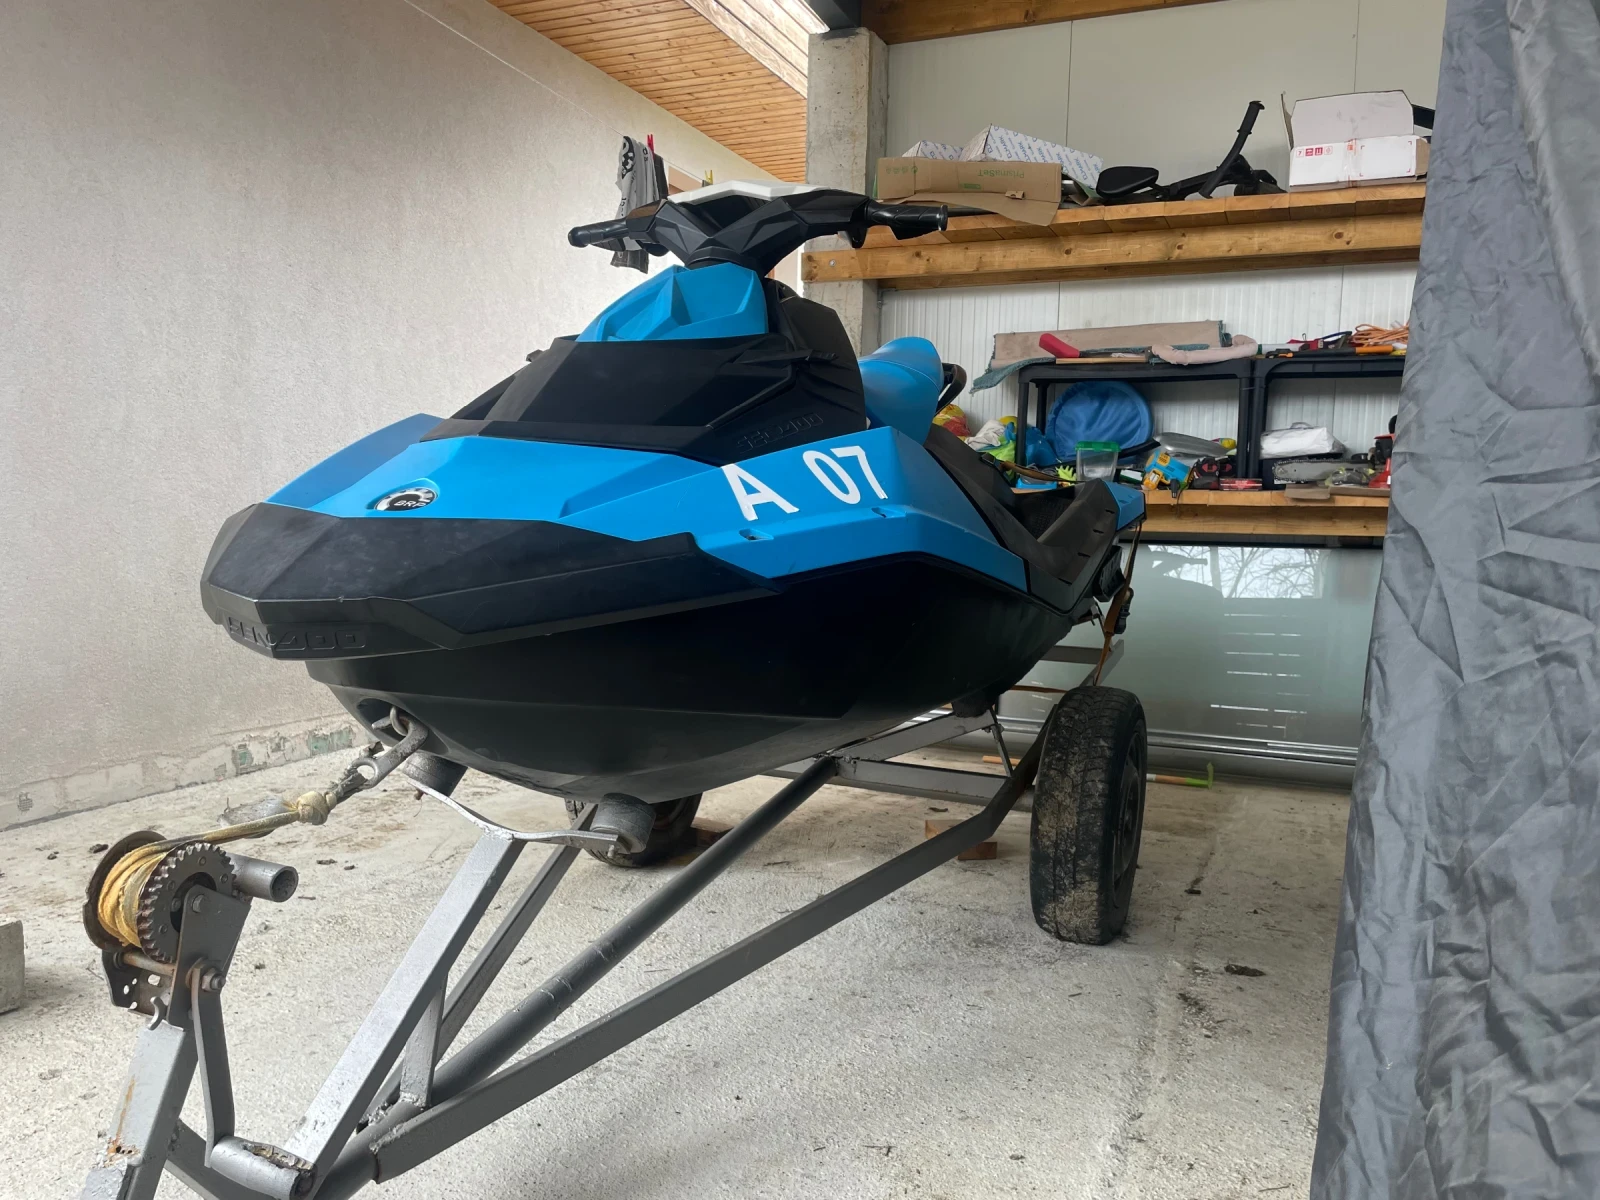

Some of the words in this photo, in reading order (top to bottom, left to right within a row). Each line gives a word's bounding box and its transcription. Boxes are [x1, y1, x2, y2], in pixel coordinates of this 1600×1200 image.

[977, 168, 1025, 179] PrismaSeT
[720, 463, 800, 521] A
[803, 446, 888, 504] 07
[393, 499, 427, 508] BRP
